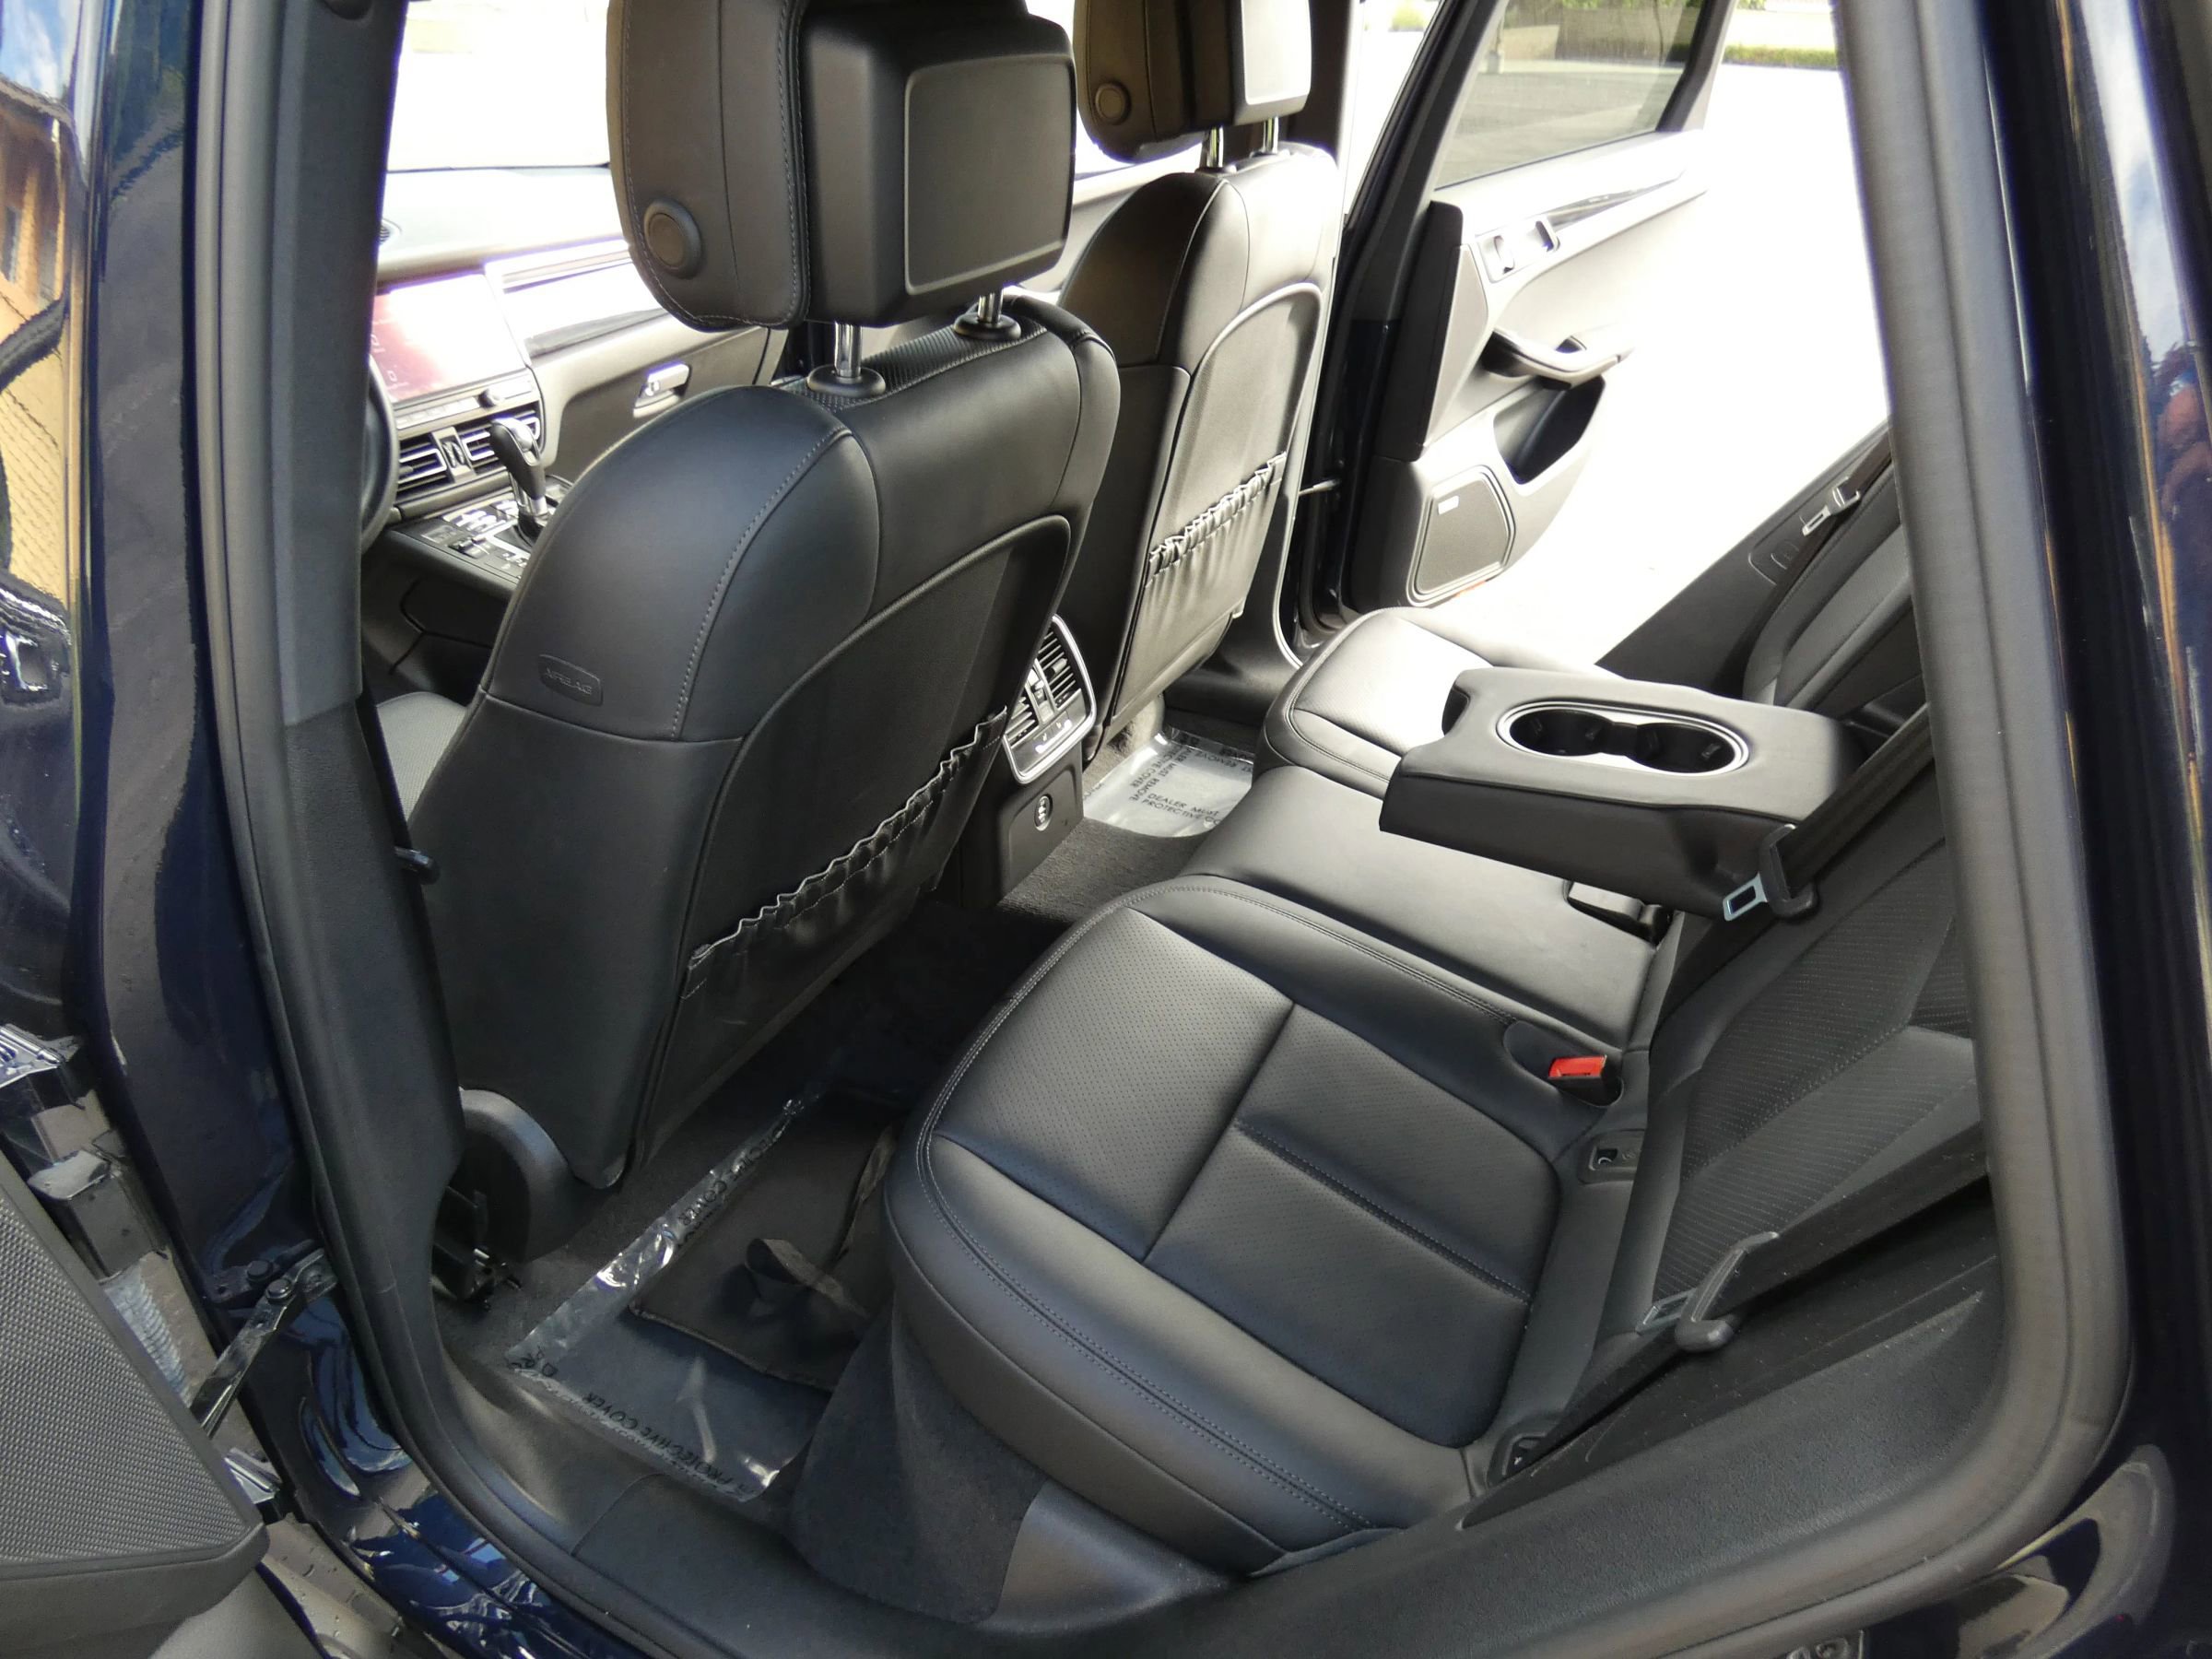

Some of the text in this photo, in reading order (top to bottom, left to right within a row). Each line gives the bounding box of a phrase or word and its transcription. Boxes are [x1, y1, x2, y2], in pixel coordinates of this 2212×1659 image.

[1141, 797, 1204, 819] PROTECTIVE
[1147, 793, 1188, 808] DEALER
[582, 1392, 734, 1486] PROTECTIVE COVER
